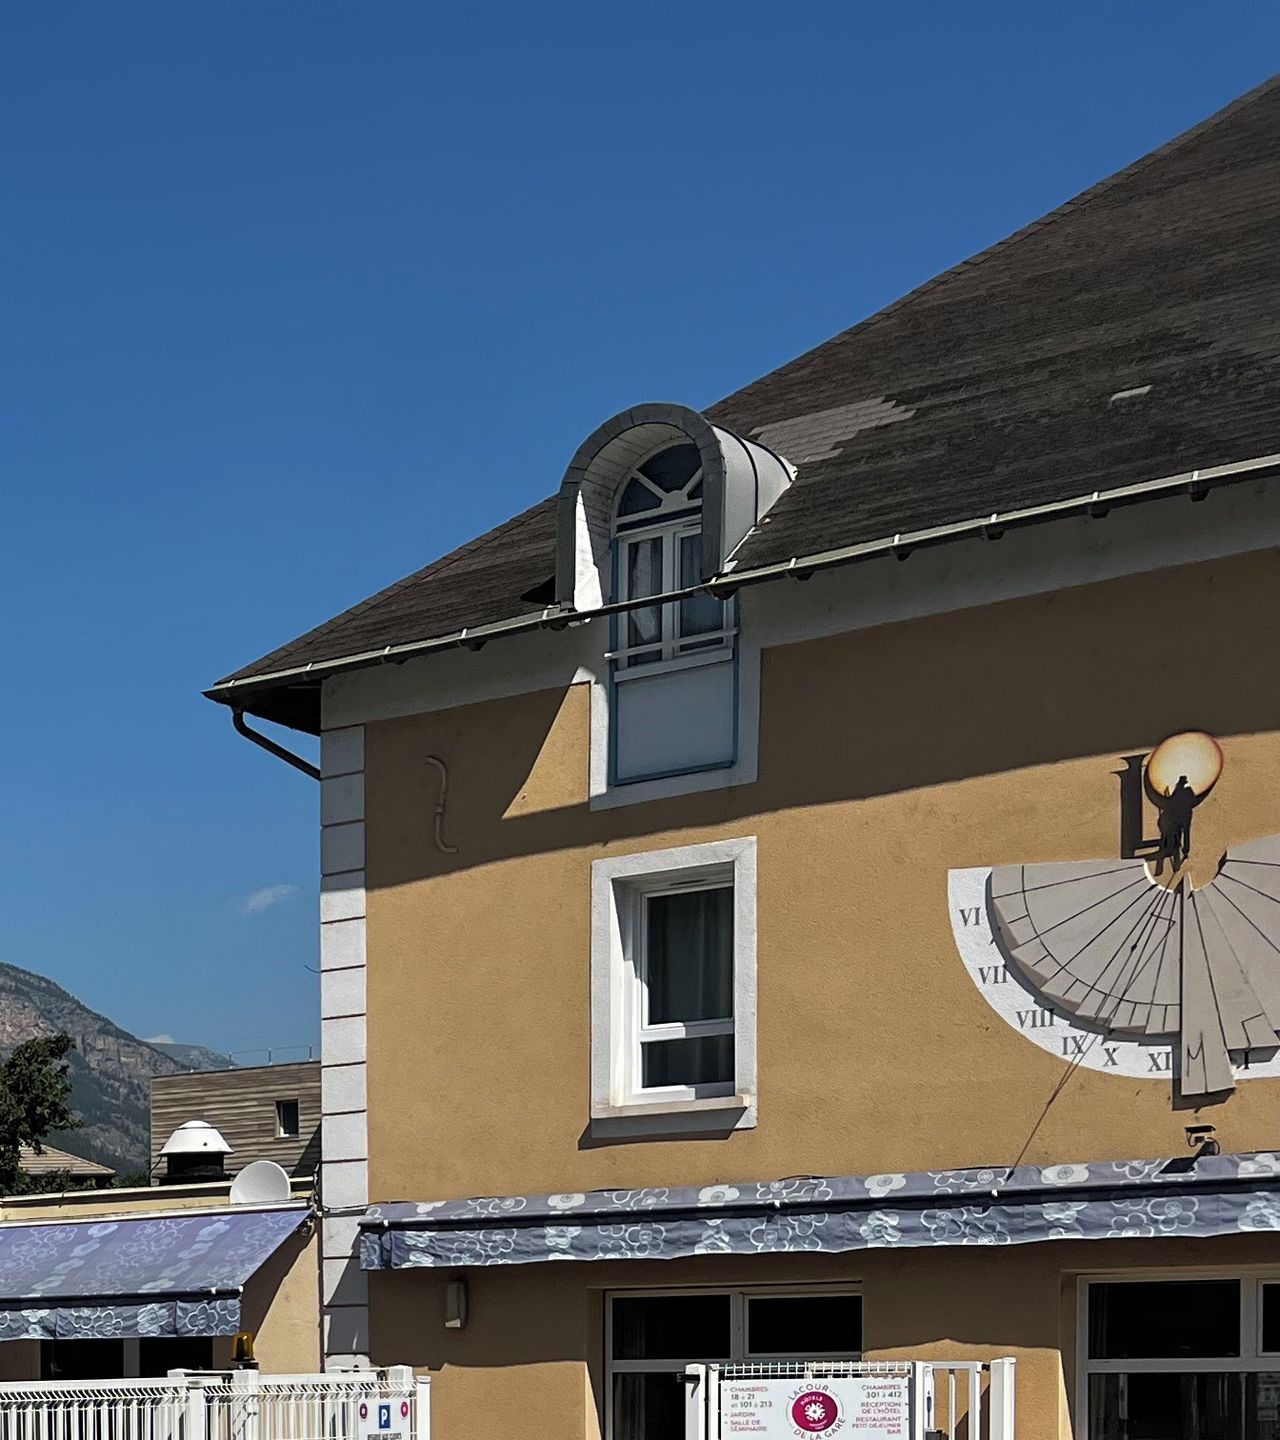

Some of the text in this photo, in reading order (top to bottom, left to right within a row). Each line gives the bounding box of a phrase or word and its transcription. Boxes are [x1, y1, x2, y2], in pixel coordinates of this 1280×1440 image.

[958, 907, 982, 926] VI
[978, 964, 1009, 984] VII
[1016, 1008, 1055, 1028] VIII
[1062, 1034, 1086, 1055] IX
[1102, 1047, 1120, 1067] X
[788, 1383, 829, 1400] LACOUR
[381, 1409, 388, 1425] P
[793, 1428, 807, 1439] DE
[824, 1417, 846, 1438] GARE
